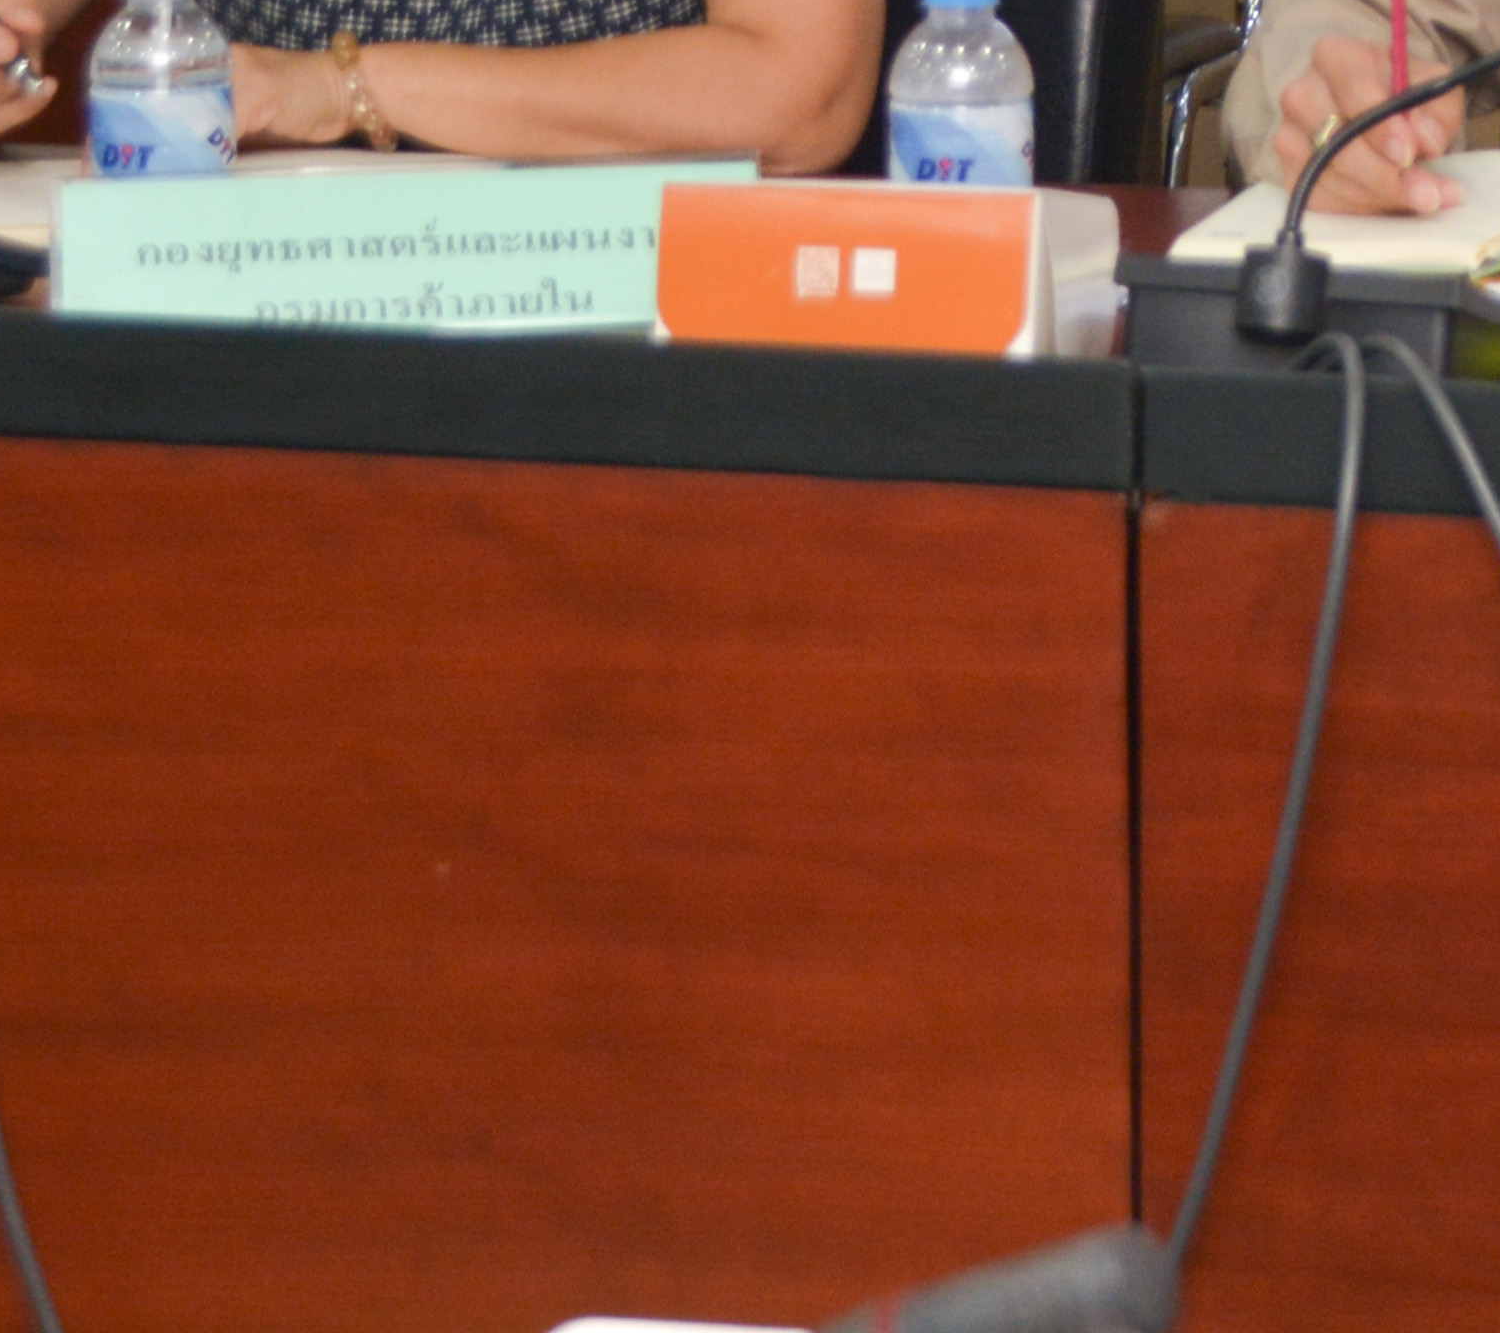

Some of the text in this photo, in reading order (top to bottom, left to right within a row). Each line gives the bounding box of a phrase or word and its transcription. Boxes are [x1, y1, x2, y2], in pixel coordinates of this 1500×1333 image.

[135, 218, 657, 274] กองยุทธศาสตร์และแผนงา
